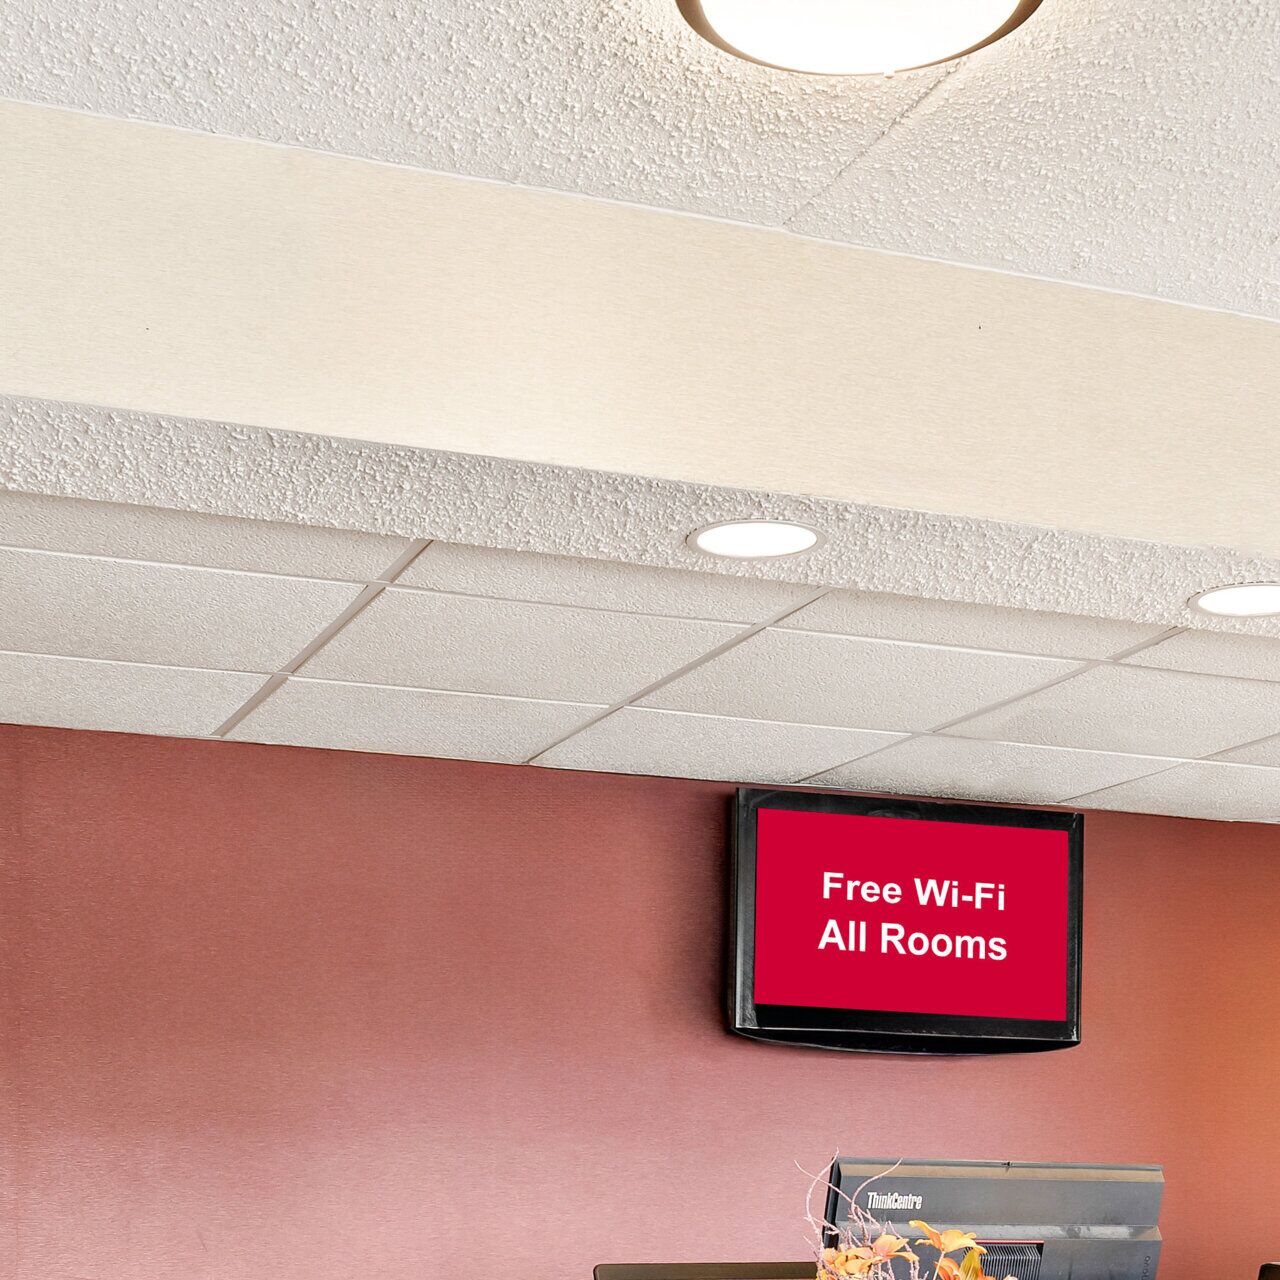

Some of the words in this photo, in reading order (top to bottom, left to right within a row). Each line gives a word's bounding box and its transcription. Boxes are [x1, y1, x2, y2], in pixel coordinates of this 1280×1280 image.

[822, 871, 902, 904] Free
[913, 877, 1005, 911] Wi-Fi
[817, 918, 867, 952] All
[880, 922, 1008, 961] Rooms
[867, 1191, 923, 1210] ThinkCentre
